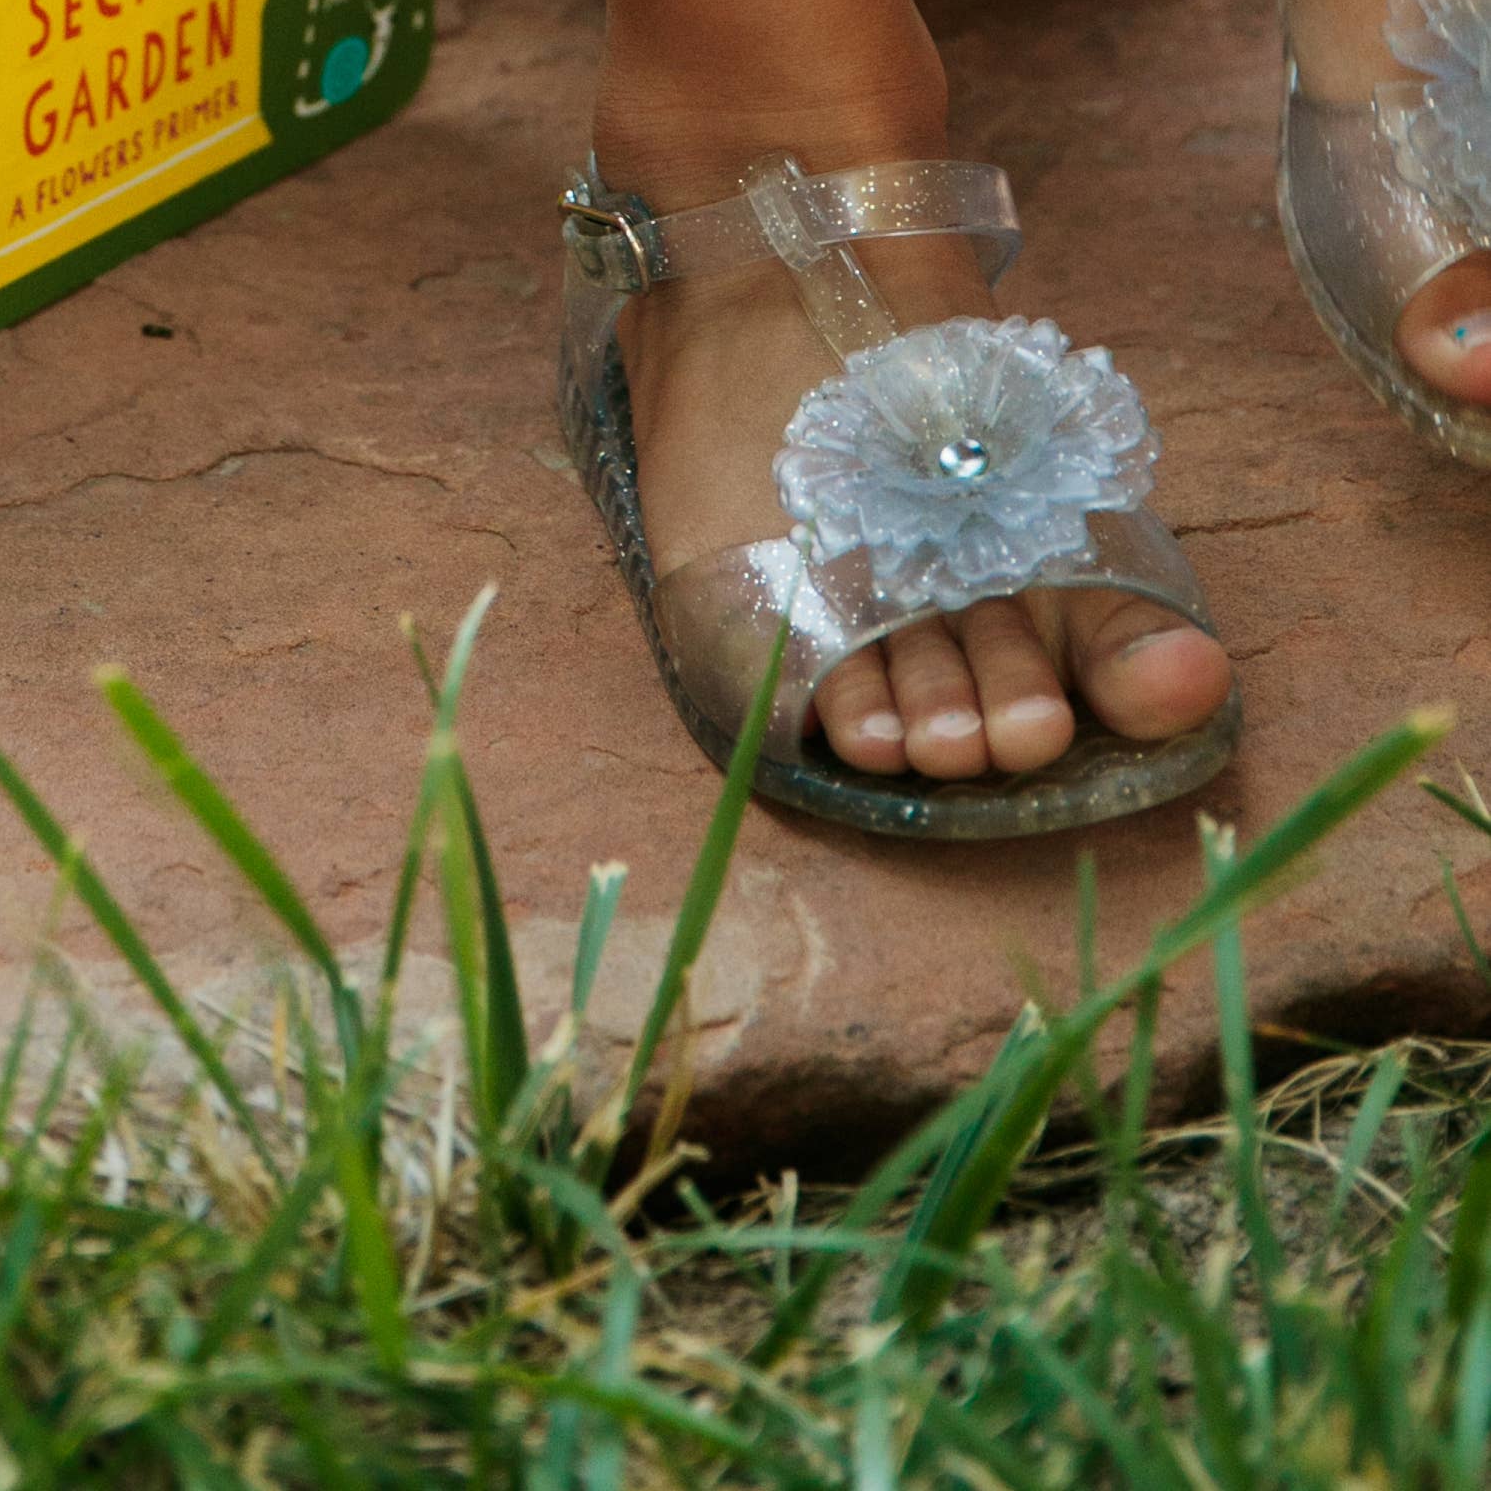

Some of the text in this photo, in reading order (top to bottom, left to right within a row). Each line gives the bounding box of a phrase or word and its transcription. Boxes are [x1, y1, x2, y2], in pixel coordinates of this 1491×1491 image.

[9, 80, 239, 228] A FLOWERS PRIMER
